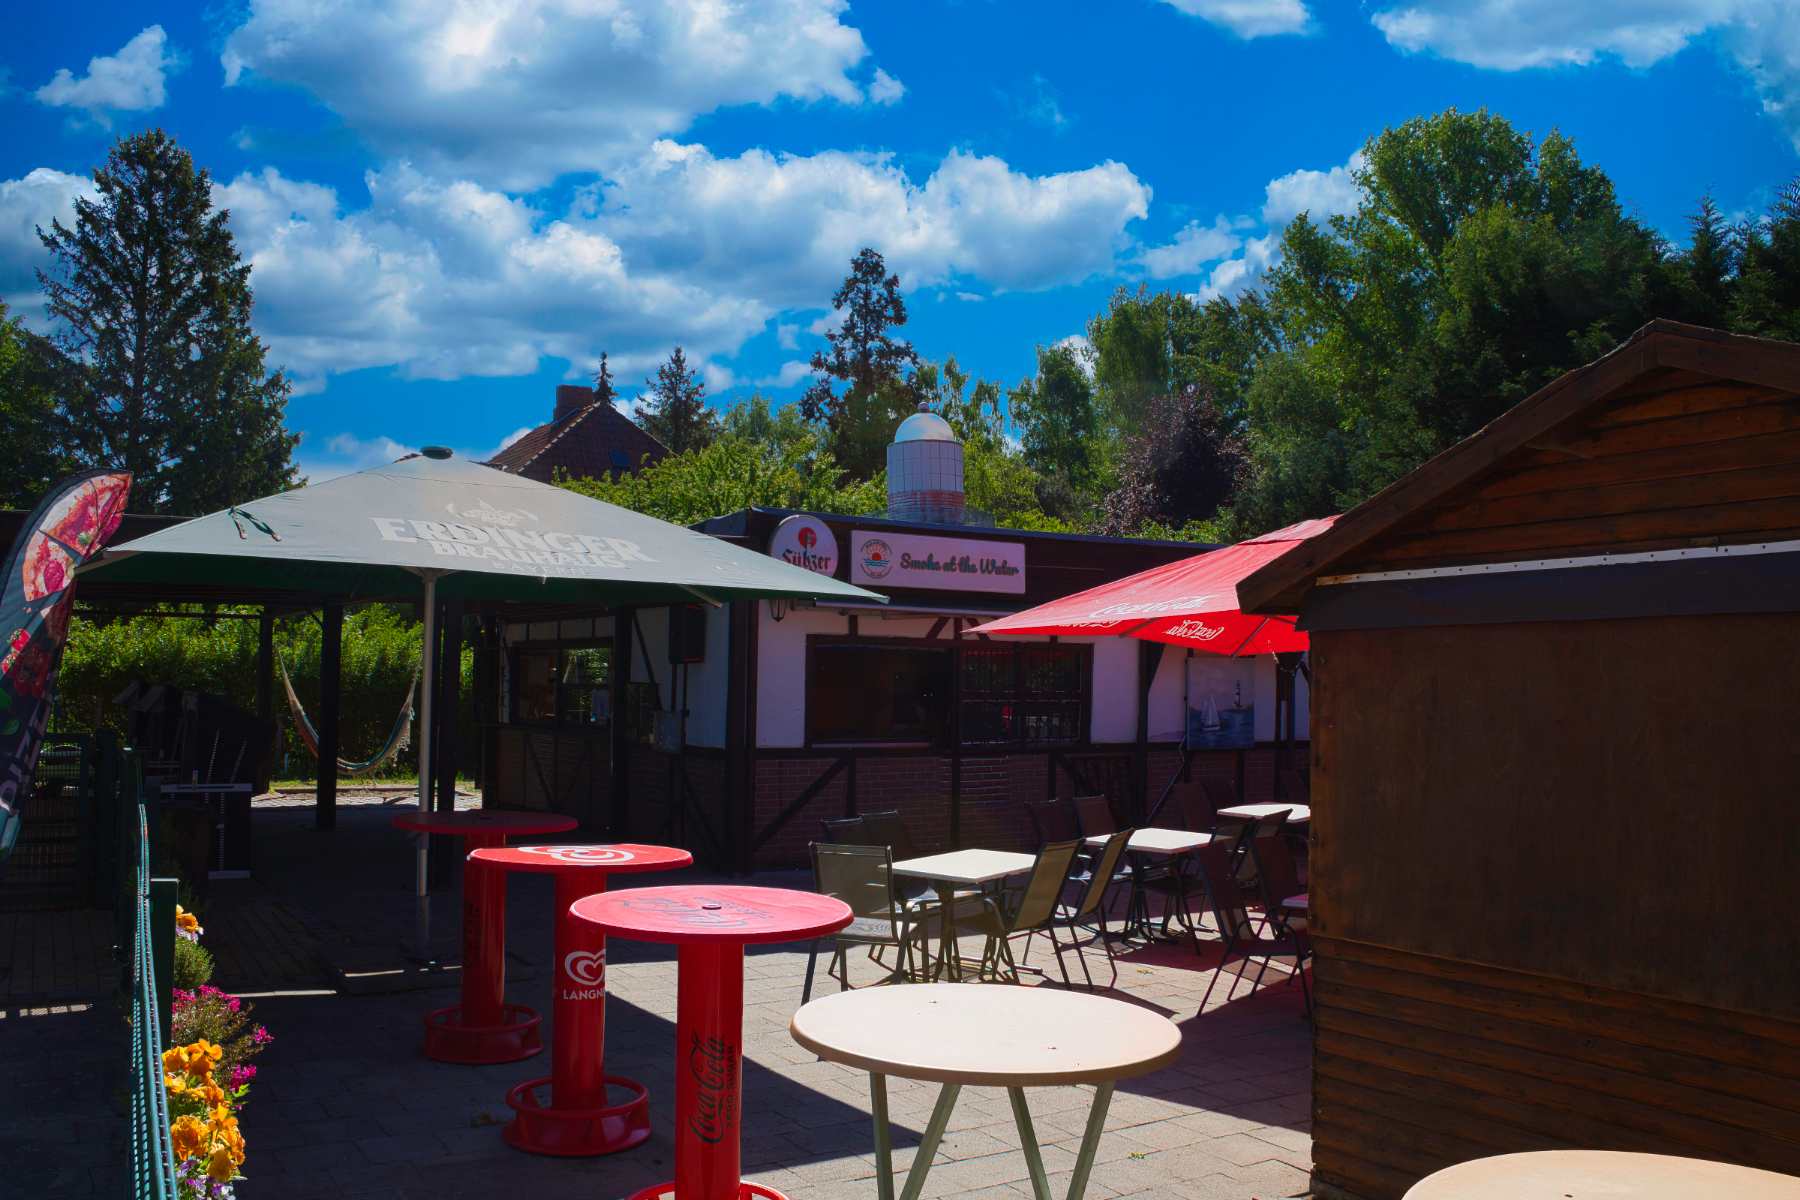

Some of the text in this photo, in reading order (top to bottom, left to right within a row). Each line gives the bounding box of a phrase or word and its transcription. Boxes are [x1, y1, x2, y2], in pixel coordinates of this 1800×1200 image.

[368, 516, 660, 563] ERDINGER
[431, 540, 626, 568] BRAUHAUS
[492, 561, 586, 575] BAYERN
[900, 552, 1019, 577] Smoke at the Water
[689, 1028, 725, 1144] Coca-Cola
[726, 1045, 734, 1130] ZERO SUGAR
